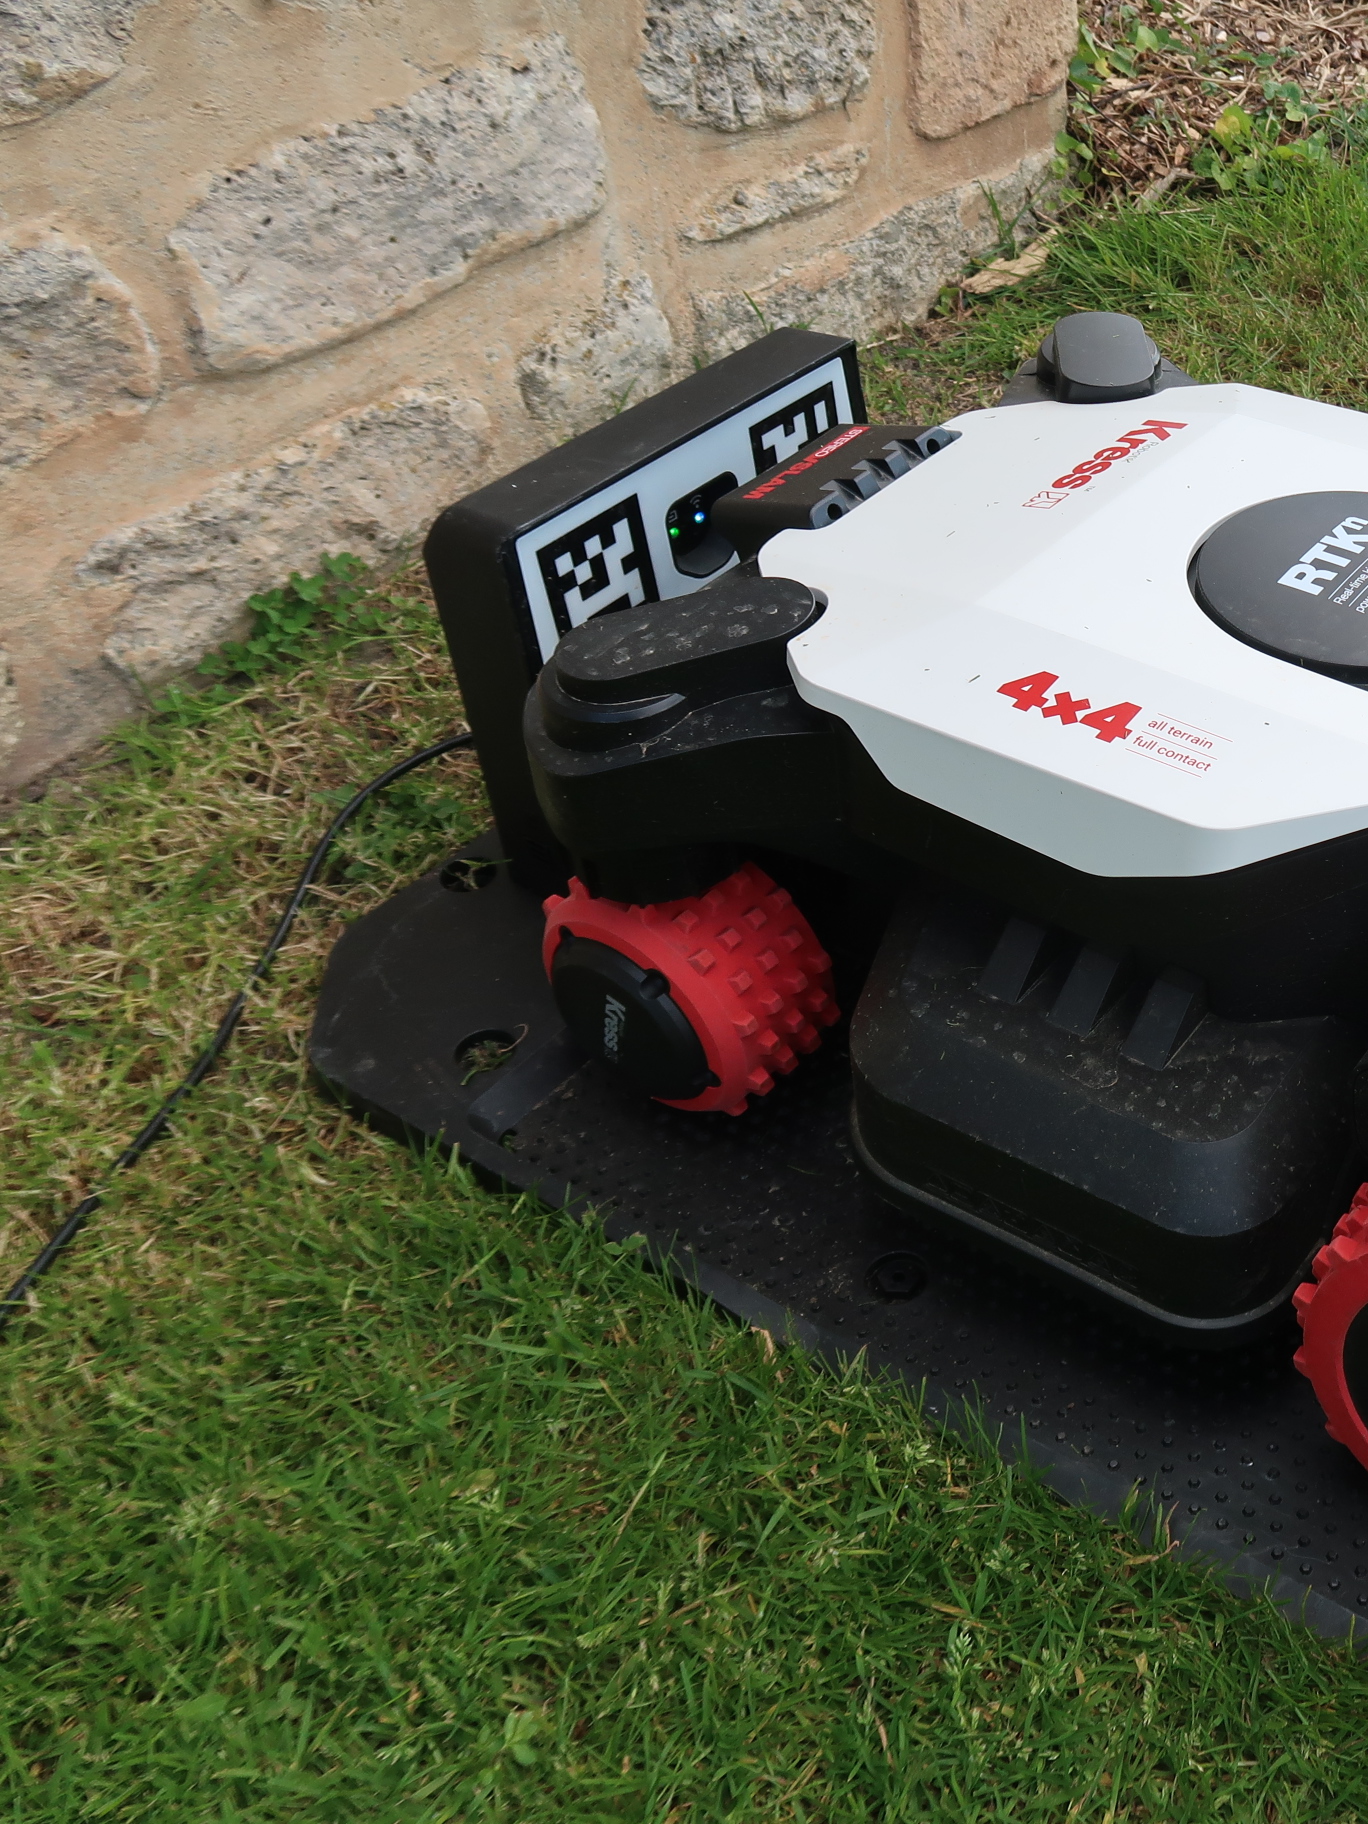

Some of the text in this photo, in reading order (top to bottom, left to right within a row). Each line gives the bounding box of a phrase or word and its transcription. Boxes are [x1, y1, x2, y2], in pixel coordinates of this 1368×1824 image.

[1051, 419, 1189, 490] Kress
[1333, 573, 1368, 605] Real-time
[1148, 718, 1213, 750] all terrain
[1132, 735, 1211, 772] full contact
[604, 994, 626, 1052] Kress
